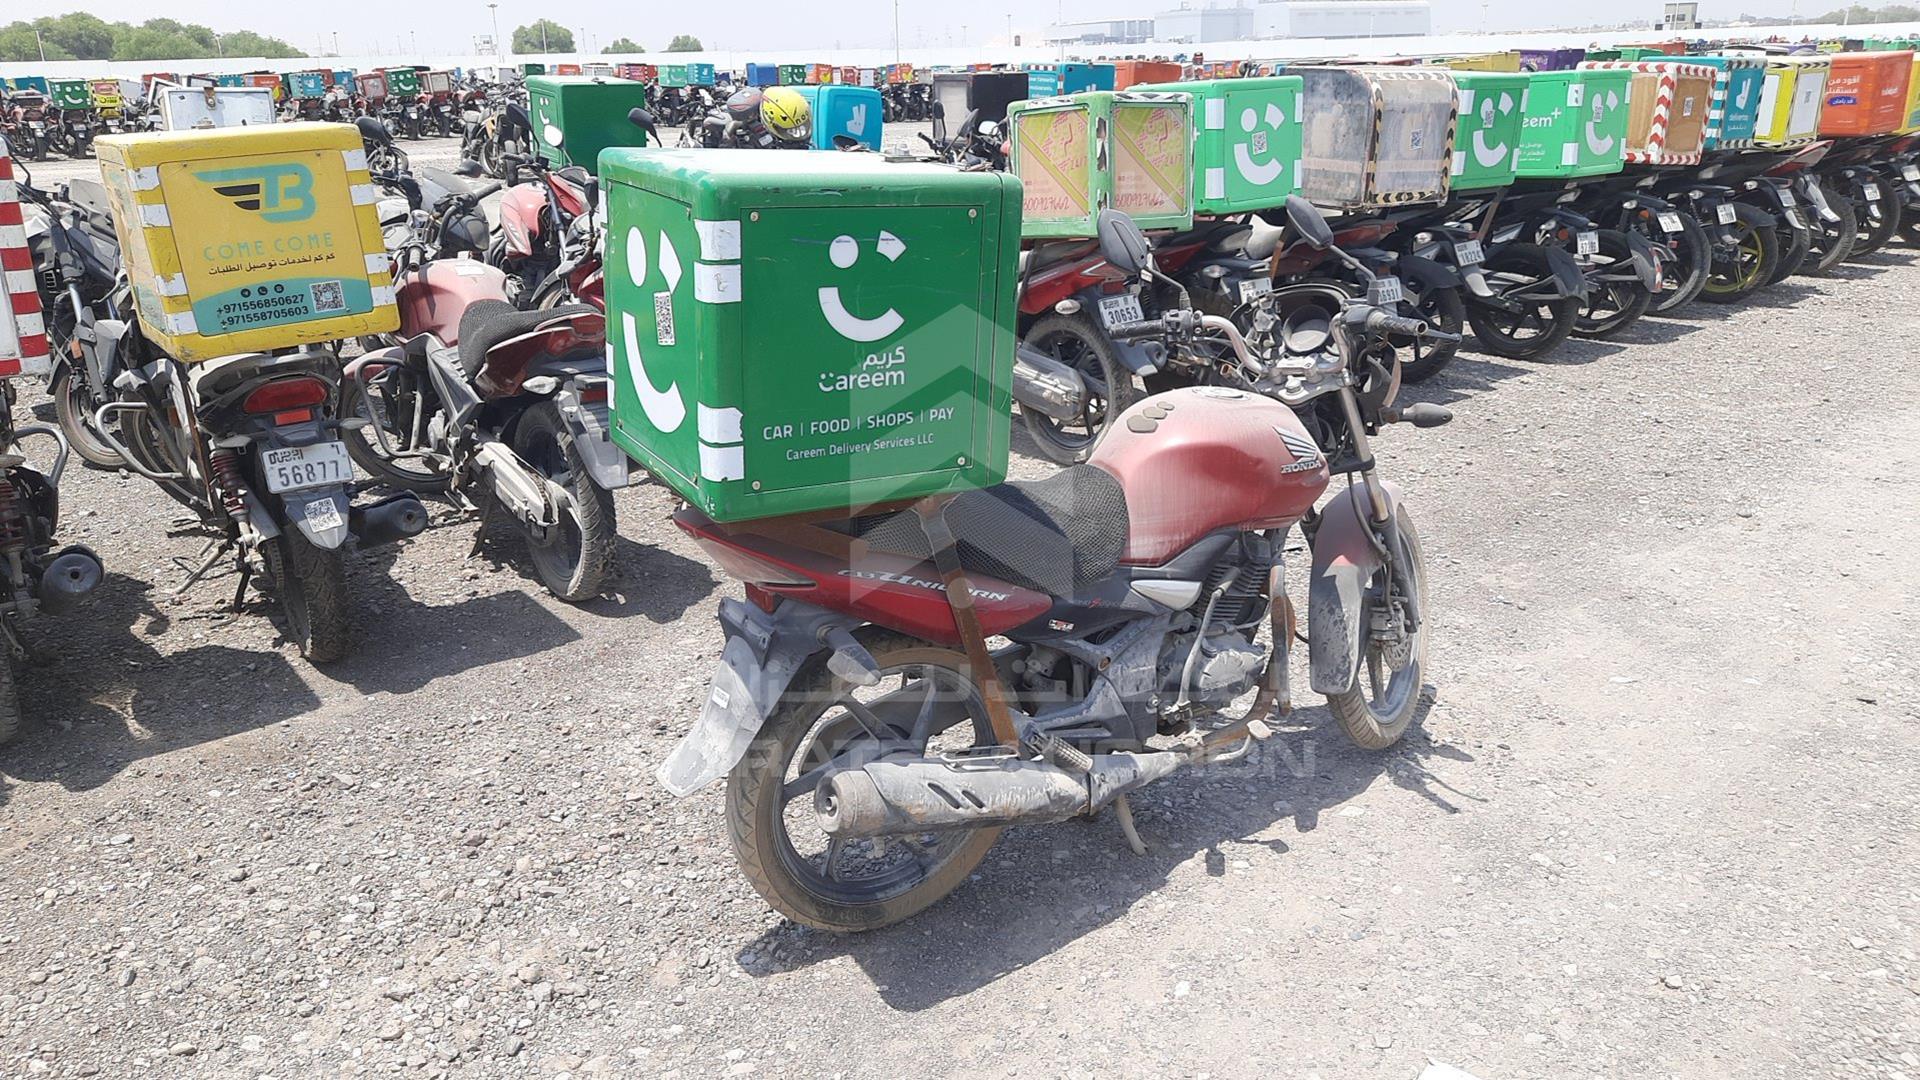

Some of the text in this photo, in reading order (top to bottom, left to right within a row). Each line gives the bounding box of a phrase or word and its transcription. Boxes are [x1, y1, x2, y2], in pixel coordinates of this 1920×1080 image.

[203, 232, 334, 261] COME COME
[208, 252, 336, 275] كم كم لخدمات توصيل الطلبات
[216, 294, 305, 315] +971556850627
[220, 305, 309, 327] +971558705603
[1108, 306, 1139, 325] 30653
[862, 345, 905, 372] كريم
[763, 407, 955, 441] CAR FOOD SHOPS PAY
[786, 433, 935, 461] Careem Delivery Services LLC
[278, 460, 339, 487] 56877
[1281, 460, 1322, 474] HONDA
